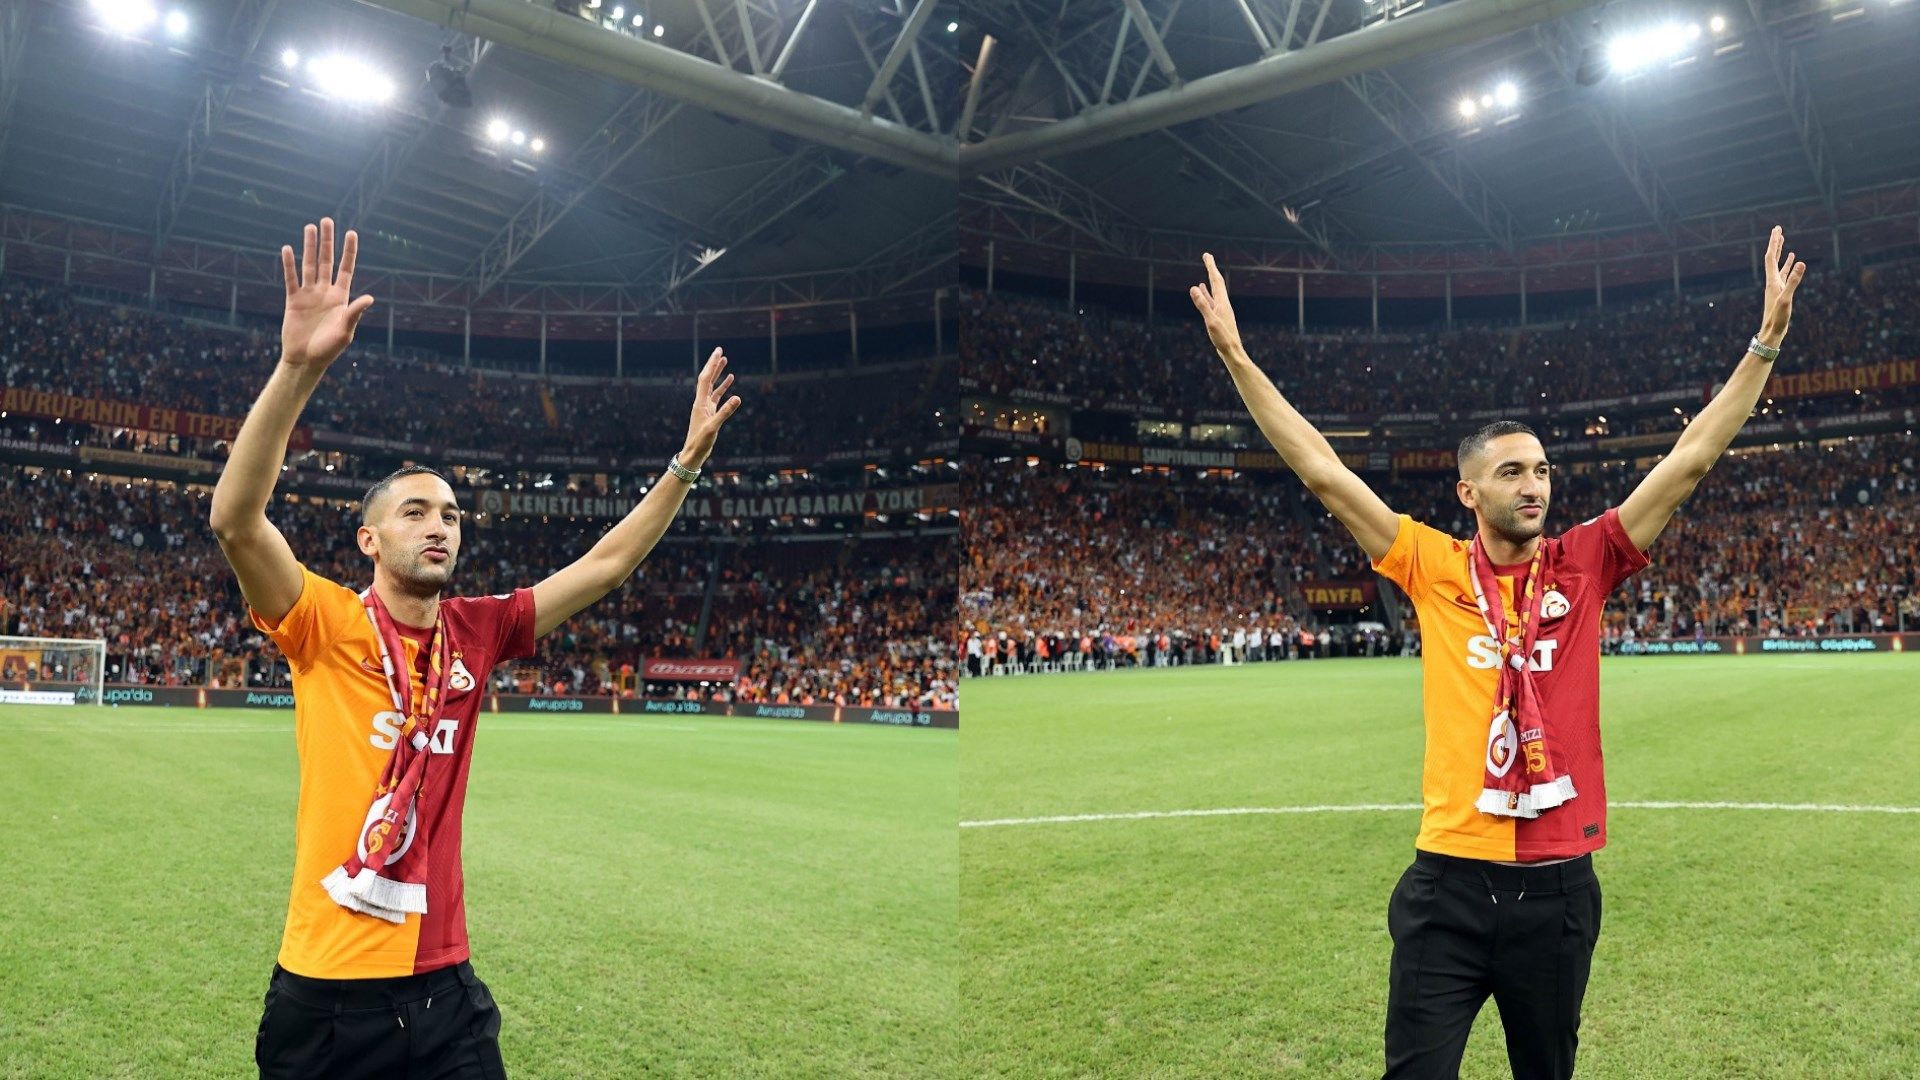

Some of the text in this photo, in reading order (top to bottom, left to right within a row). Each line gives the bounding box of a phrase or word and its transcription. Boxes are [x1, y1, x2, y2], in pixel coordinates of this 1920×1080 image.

[151, 408, 178, 431] EN
[721, 490, 866, 518] GALATASARAY
[1304, 587, 1364, 604] TAYFA
